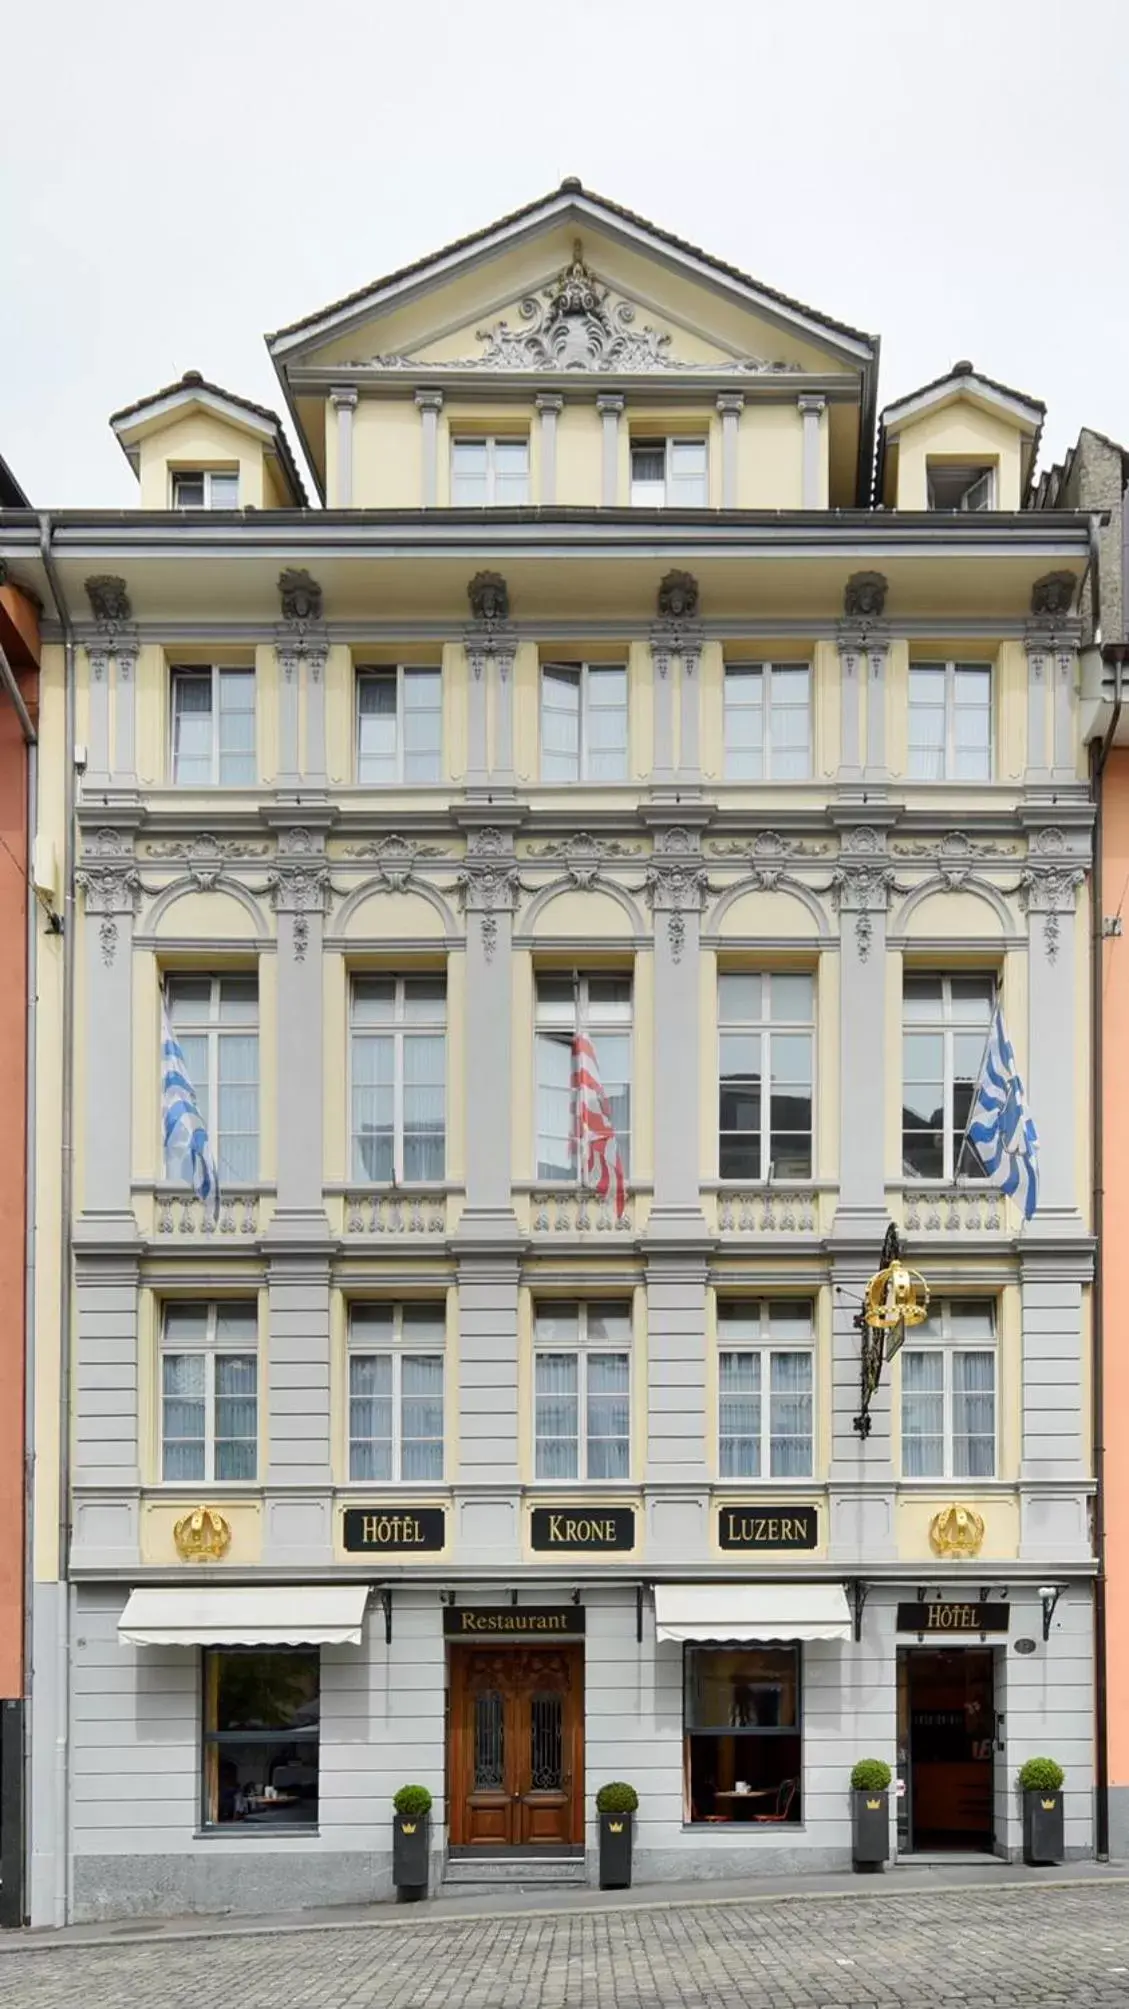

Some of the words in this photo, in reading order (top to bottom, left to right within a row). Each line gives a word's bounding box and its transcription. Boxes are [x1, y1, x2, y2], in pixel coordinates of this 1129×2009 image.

[548, 1515, 617, 1542] KRONE
[728, 1514, 808, 1541] LUZERN
[461, 1611, 568, 1630] Restaurant
